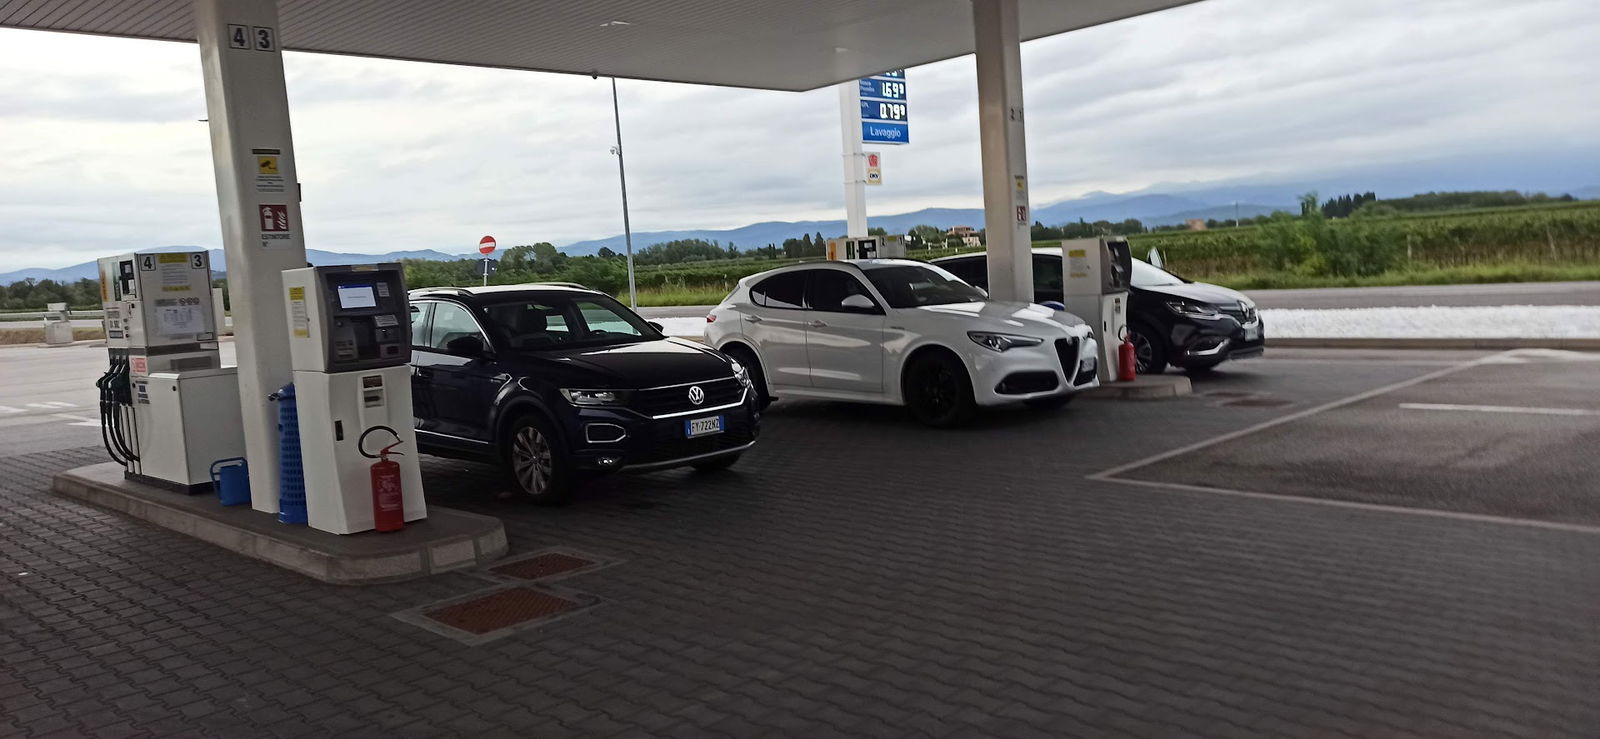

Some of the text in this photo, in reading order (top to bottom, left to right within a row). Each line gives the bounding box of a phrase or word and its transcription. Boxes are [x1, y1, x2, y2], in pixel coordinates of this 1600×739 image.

[233, 28, 270, 49] 4 3
[870, 127, 901, 139] Lavaggio
[144, 256, 152, 269] 4
[194, 254, 202, 267] 3
